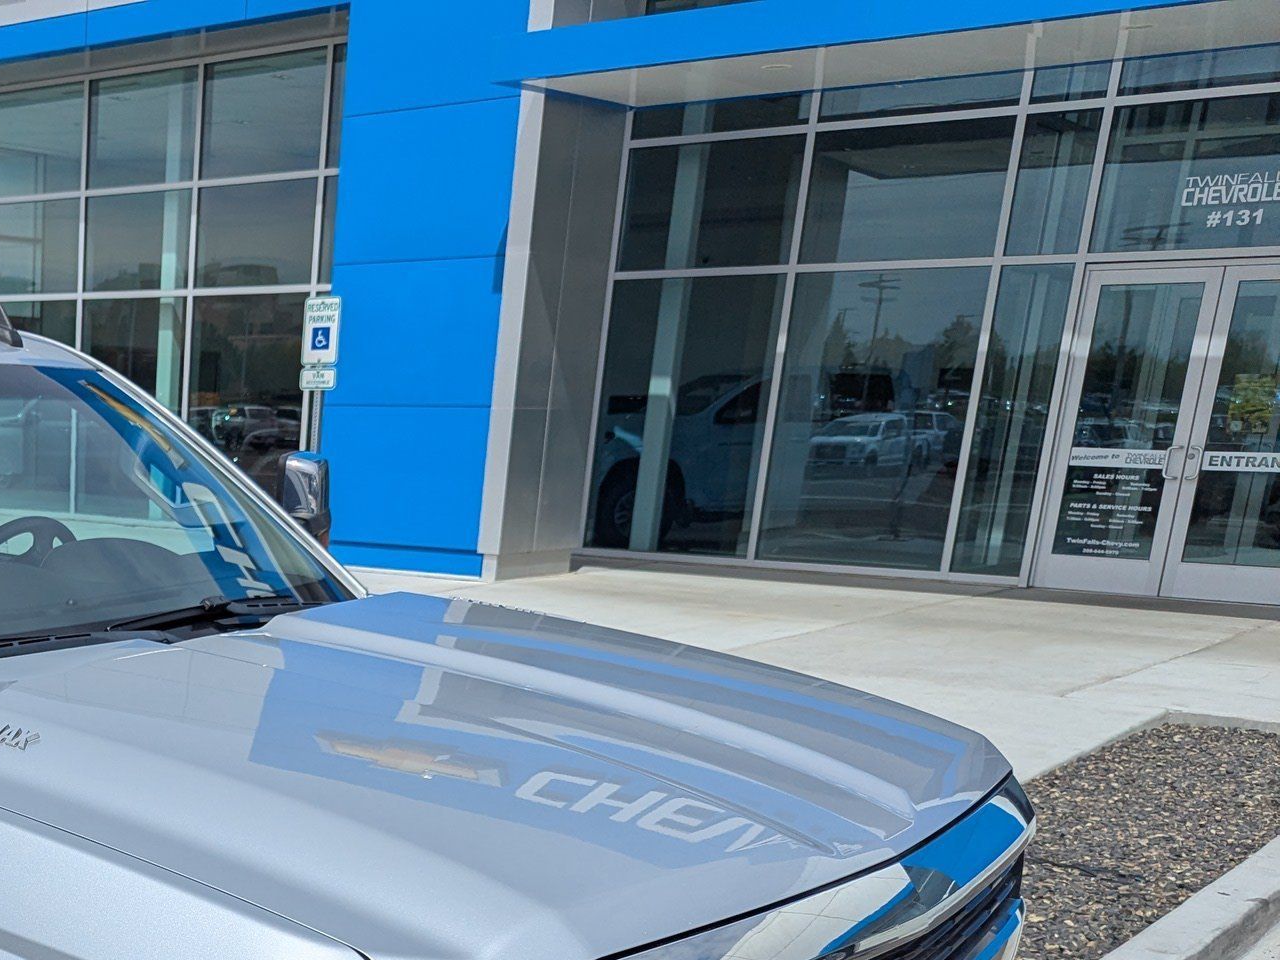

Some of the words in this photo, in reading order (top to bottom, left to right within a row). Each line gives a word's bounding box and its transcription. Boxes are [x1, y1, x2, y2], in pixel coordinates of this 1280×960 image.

[1206, 208, 1264, 228] #131
[307, 302, 339, 312] RESERVED
[308, 314, 336, 324] PARKING
[1208, 455, 1280, 468] ENTRAN
